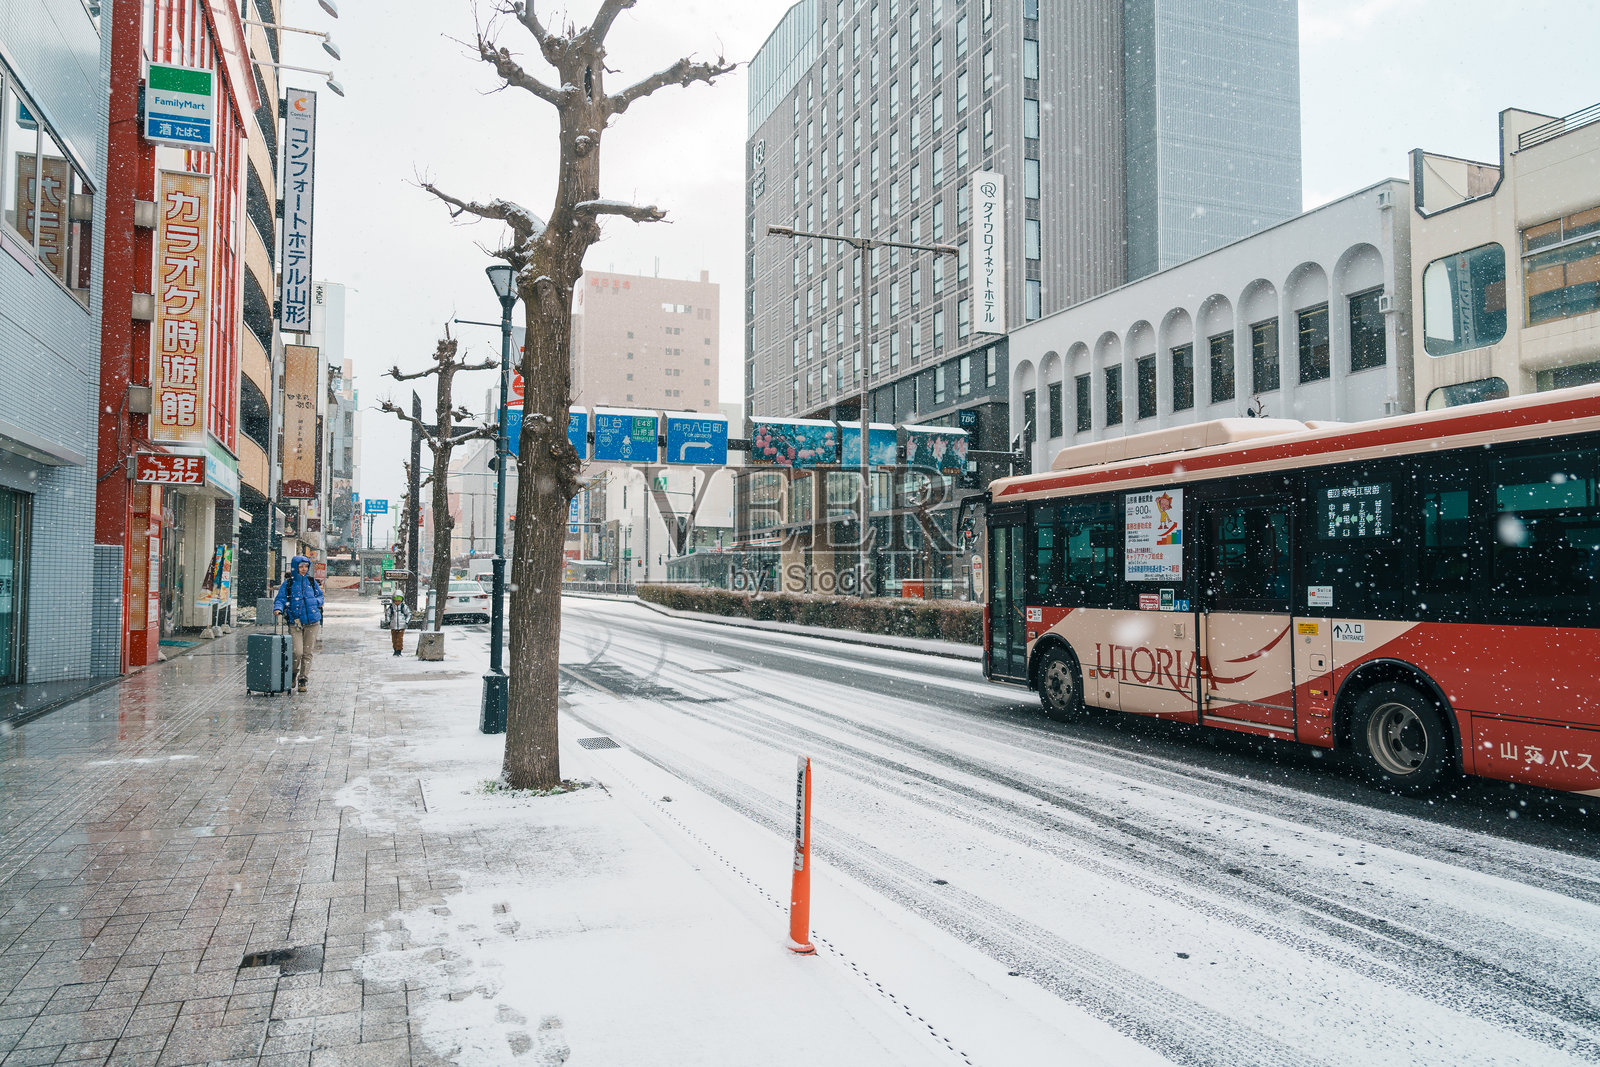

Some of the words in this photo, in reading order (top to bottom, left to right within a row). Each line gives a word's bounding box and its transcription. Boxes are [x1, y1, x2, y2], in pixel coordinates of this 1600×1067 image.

[154, 96, 205, 111] FamilyMart
[159, 123, 172, 136] 酒
[175, 126, 202, 139] たばこ
[285, 126, 310, 323] コンフォートホテル山形
[982, 201, 995, 323] ダイワロイネットホテル
[160, 191, 200, 427] カラオケ時遊館
[598, 416, 623, 428] 仙台
[673, 421, 722, 433] 市内八日町
[632, 428, 655, 436] 山形道
[622, 446, 631, 454] 16
[173, 458, 199, 470] 2F
[142, 469, 199, 483] カラオケ
[1344, 623, 1362, 634] 入口
[1342, 634, 1364, 642] ENTRANCE
[1095, 642, 1219, 691] UTORIA
[1500, 741, 1597, 774] 山交バス
